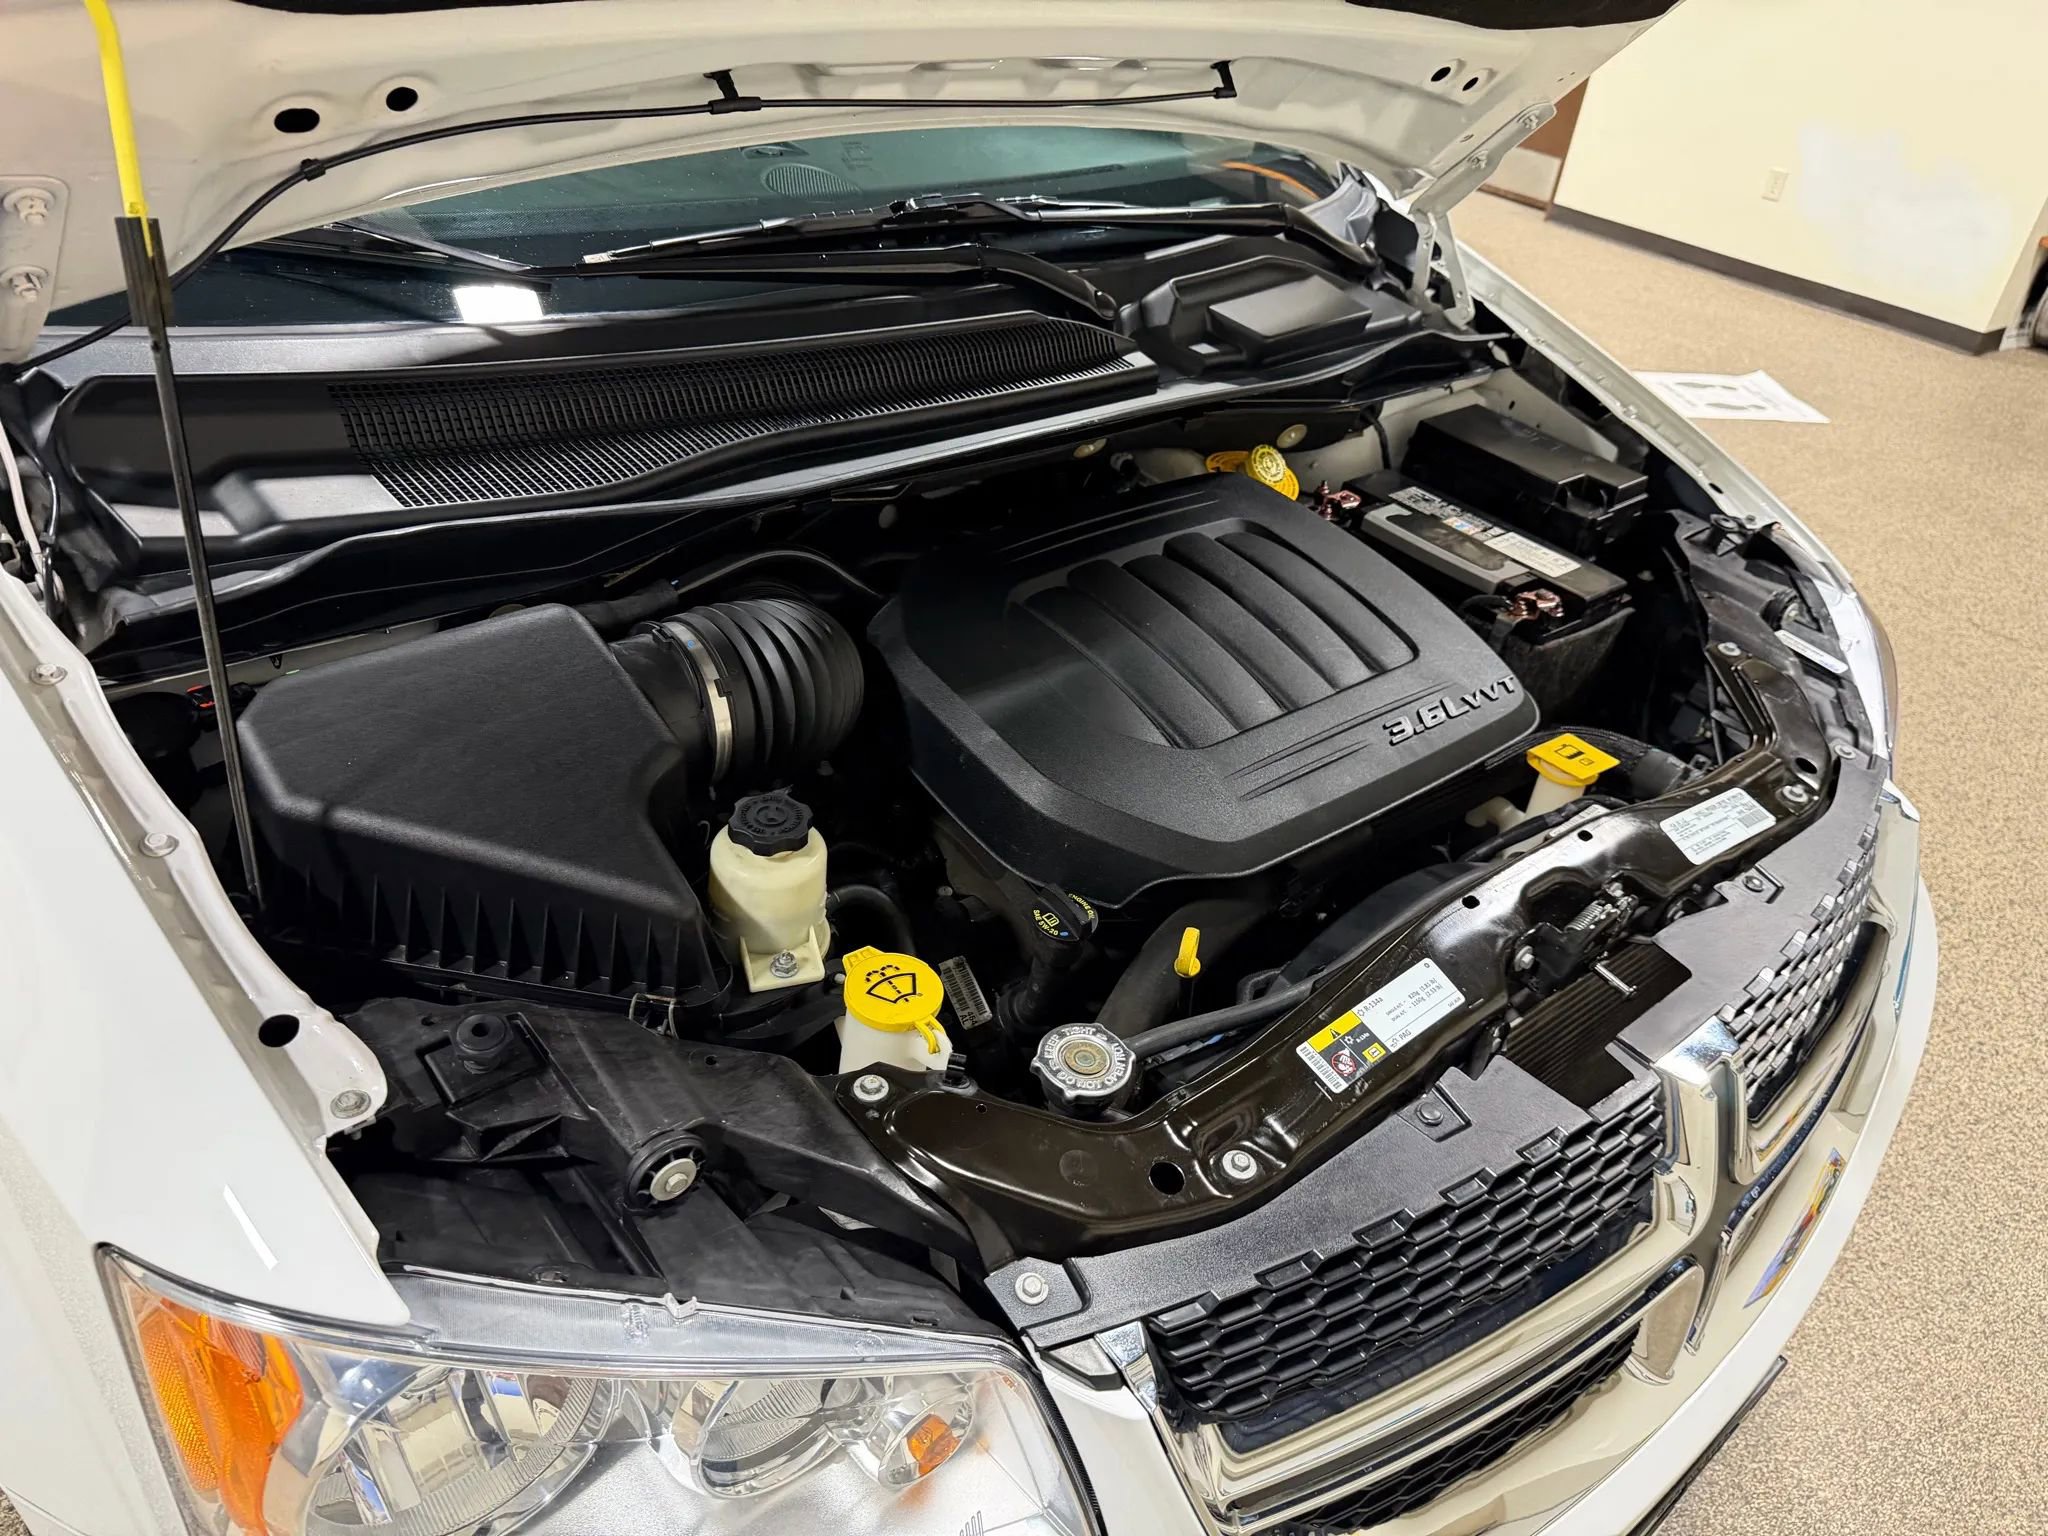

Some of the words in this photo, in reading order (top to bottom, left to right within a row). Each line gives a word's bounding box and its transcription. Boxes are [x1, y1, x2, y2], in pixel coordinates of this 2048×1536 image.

[1382, 696, 1469, 746] 3.6L
[1461, 674, 1516, 710] VVT
[1068, 893, 1091, 910] ENGINE
[1033, 909, 1042, 921] SAE
[1038, 920, 1059, 936] 5W-20
[1043, 1034, 1060, 1059] KEEP
[1061, 1026, 1097, 1036] TIGHT
[1399, 1029, 1412, 1040] PAG
[1056, 1071, 1075, 1085] DO
[1076, 1079, 1102, 1089] NOT
